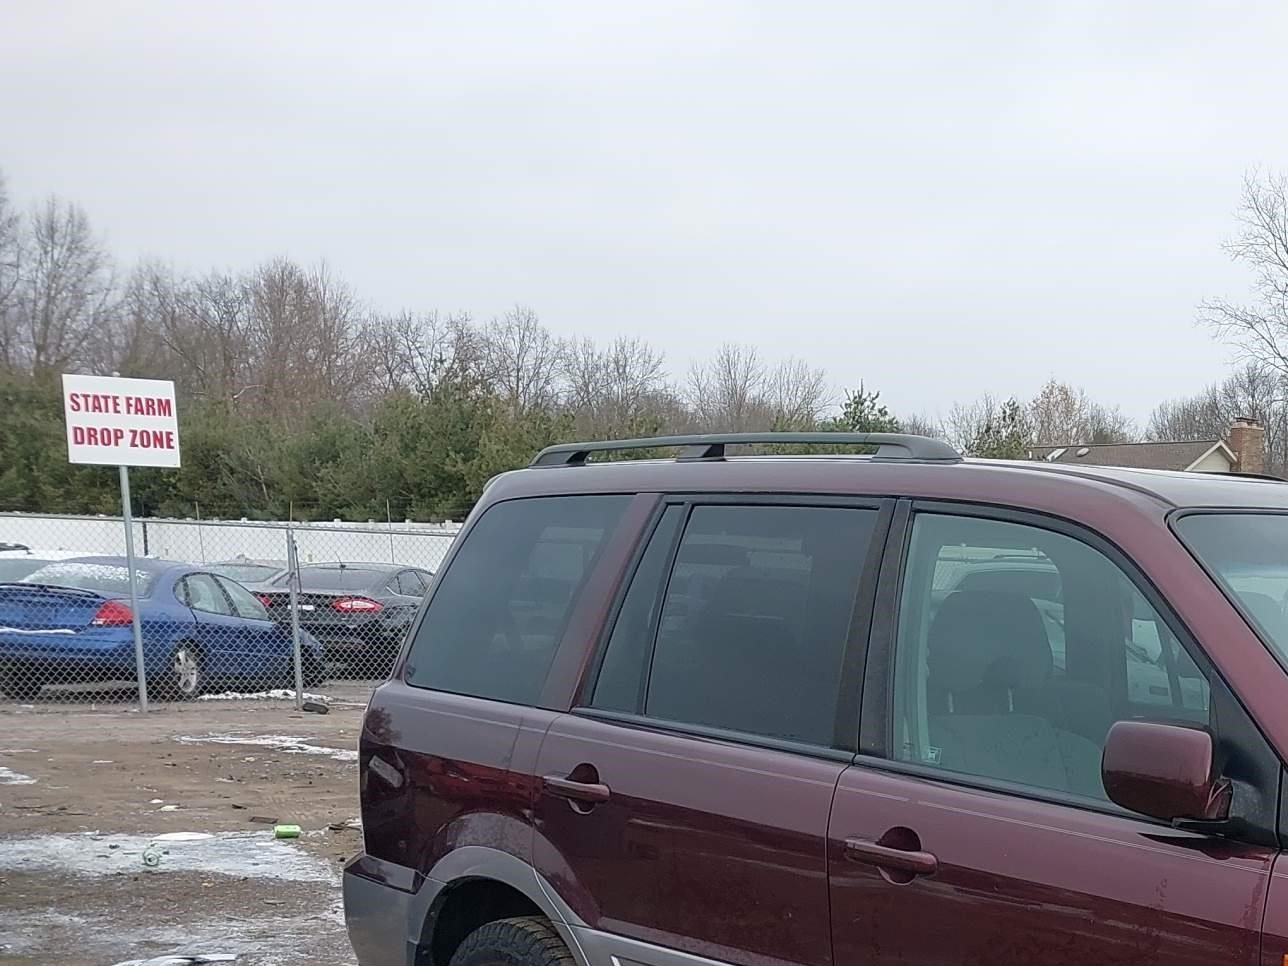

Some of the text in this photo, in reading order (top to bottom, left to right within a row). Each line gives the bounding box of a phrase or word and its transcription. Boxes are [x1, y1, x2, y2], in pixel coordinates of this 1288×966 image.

[70, 393, 172, 416] STATE FARM
[73, 426, 174, 448] DROP ZONE
